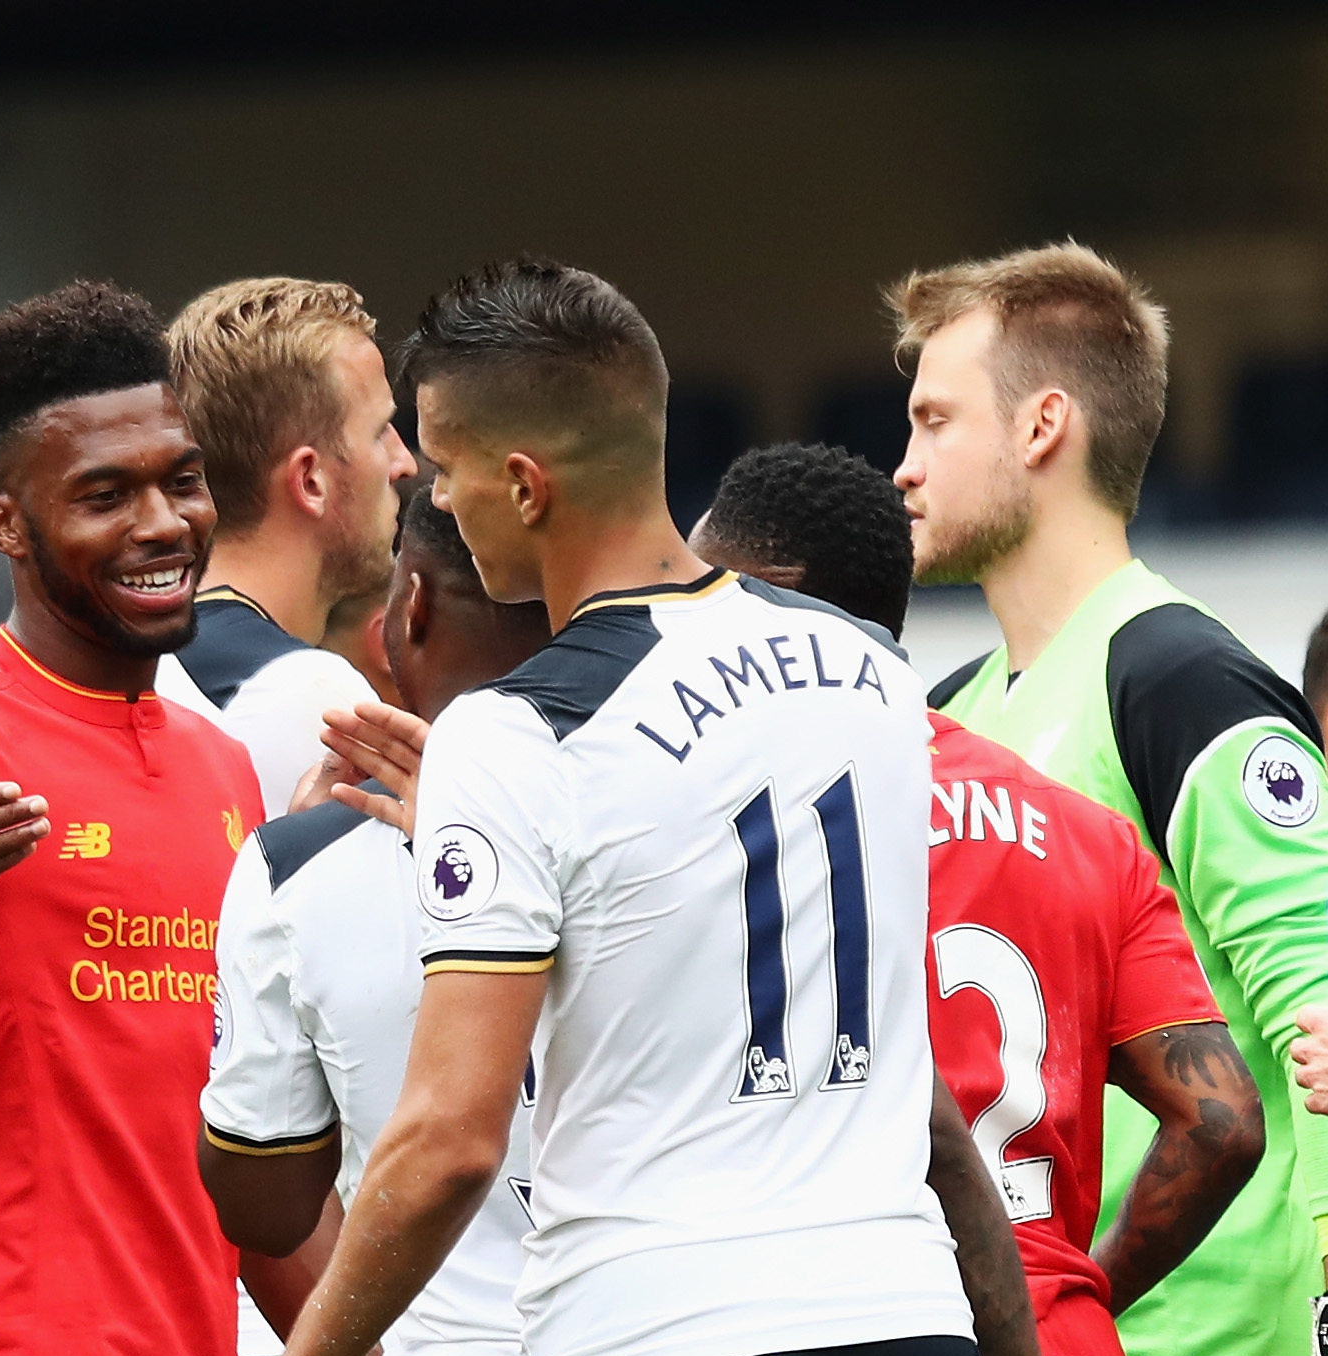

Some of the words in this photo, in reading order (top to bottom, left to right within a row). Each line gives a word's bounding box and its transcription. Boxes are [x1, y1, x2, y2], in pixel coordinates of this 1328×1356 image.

[635, 633, 890, 763] LAMELA
[84, 906, 219, 951] Standar
[726, 761, 876, 1102] 11
[70, 959, 218, 1003] Chartere
